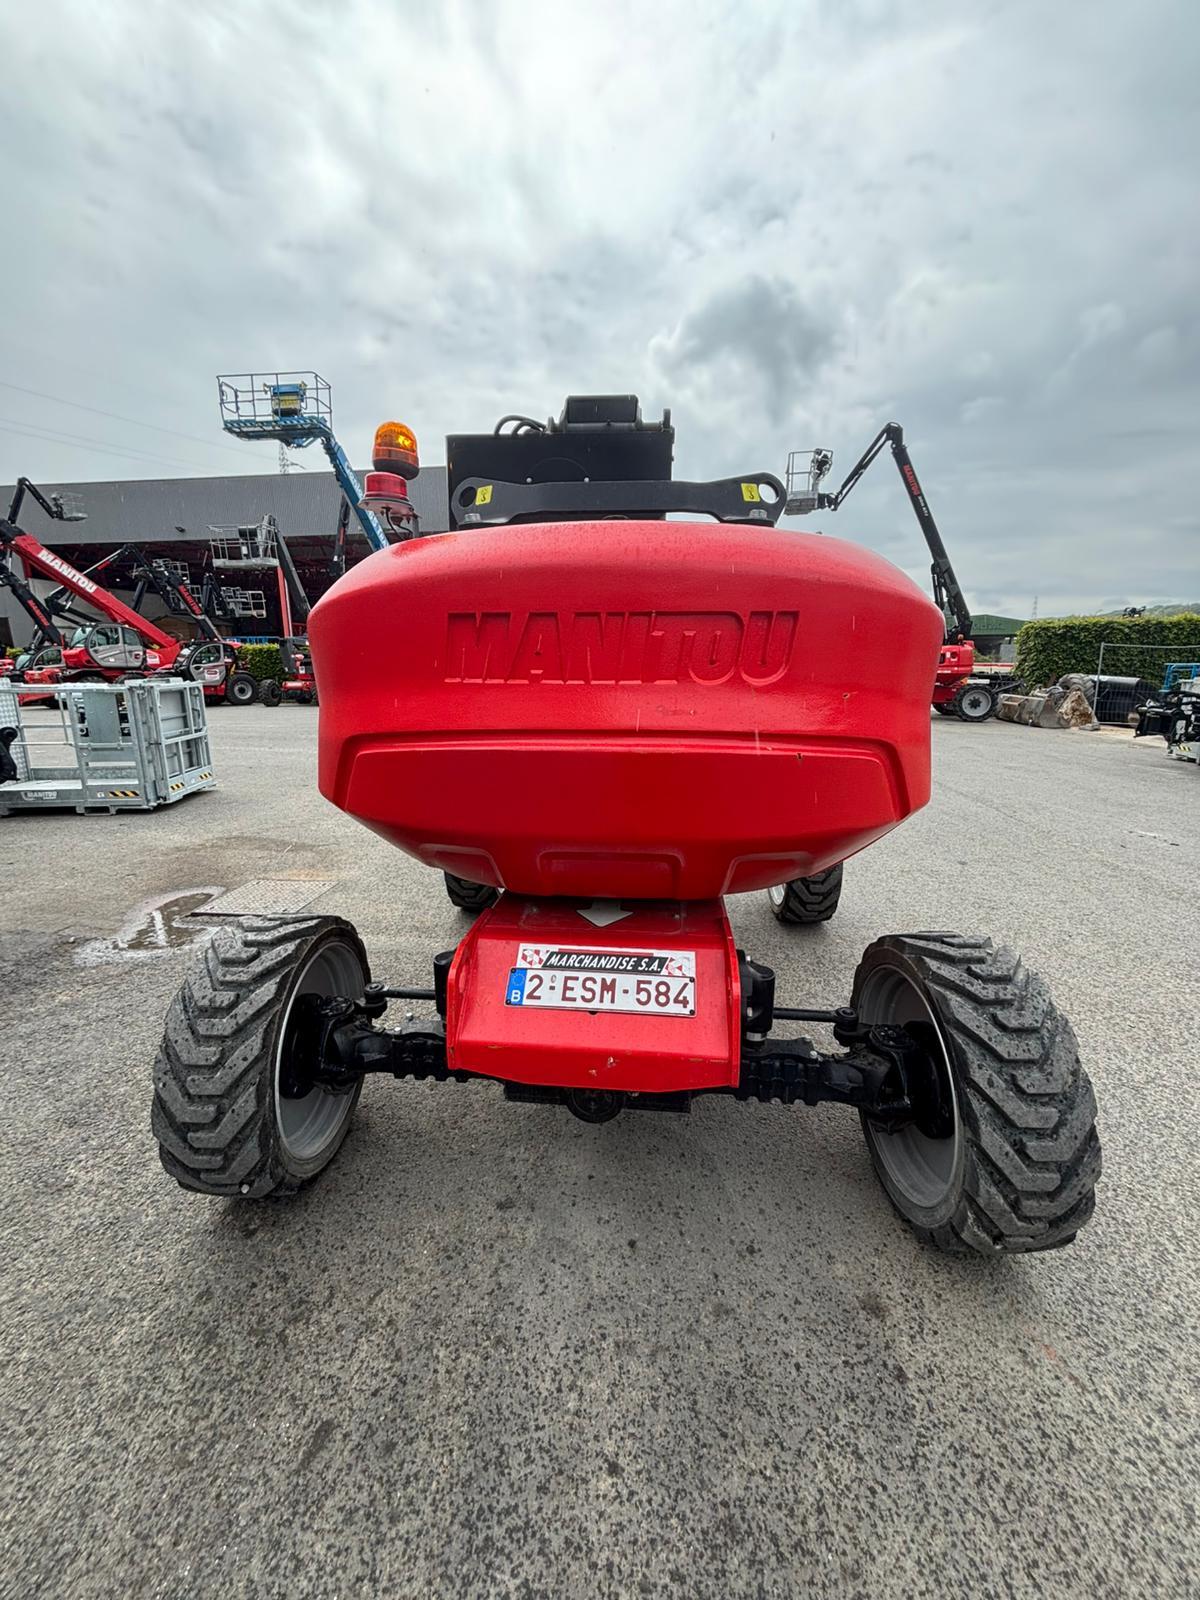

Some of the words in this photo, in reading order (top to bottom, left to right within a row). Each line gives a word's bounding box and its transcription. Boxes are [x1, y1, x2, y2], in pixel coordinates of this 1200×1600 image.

[37, 549, 98, 593] MANITOU
[444, 610, 800, 686] MANITOU
[546, 953, 638, 971] MARCHANDISE
[638, 957, 662, 972] S.A.
[510, 989, 521, 1003] B
